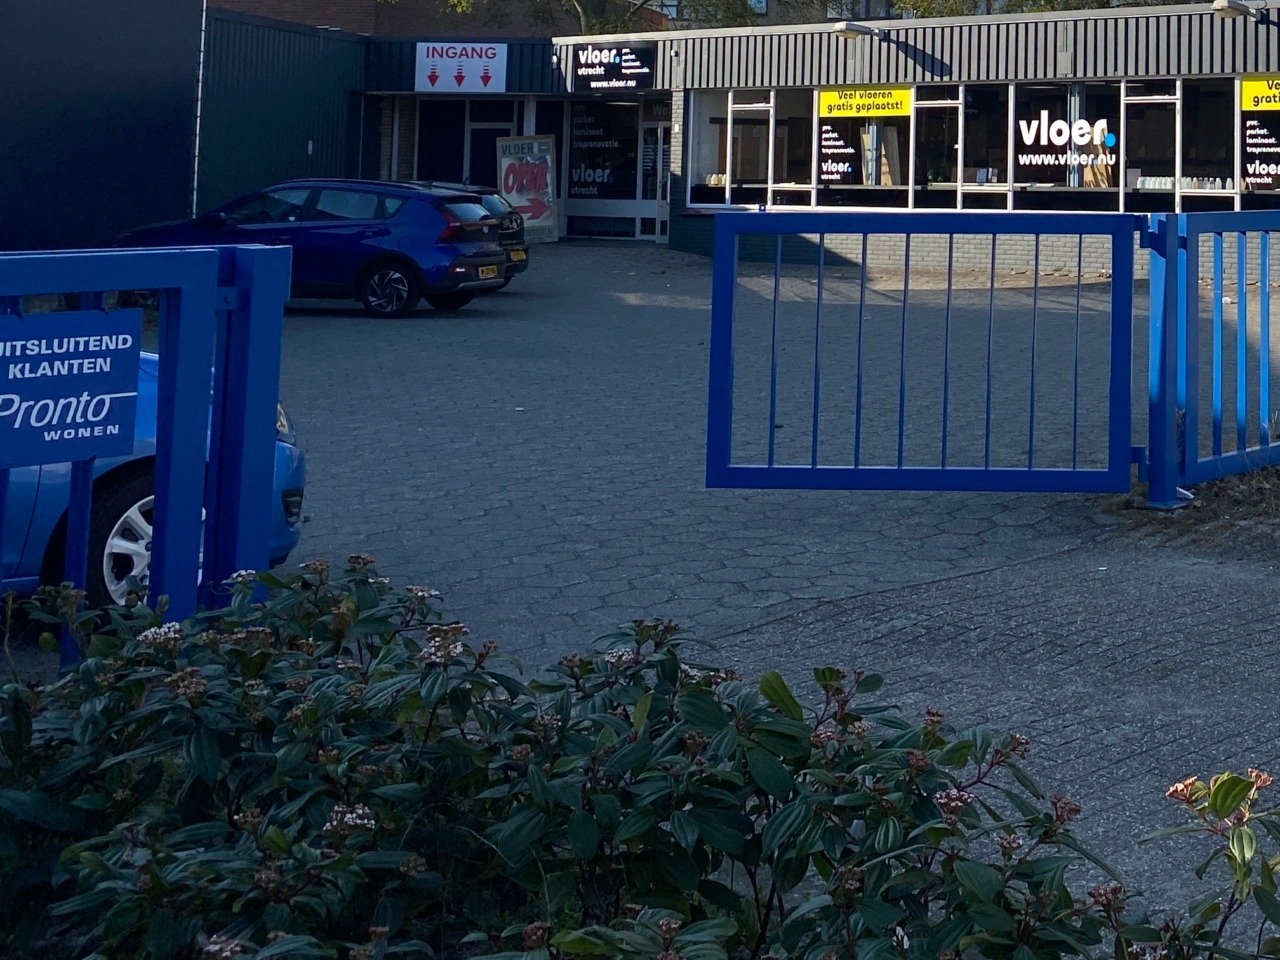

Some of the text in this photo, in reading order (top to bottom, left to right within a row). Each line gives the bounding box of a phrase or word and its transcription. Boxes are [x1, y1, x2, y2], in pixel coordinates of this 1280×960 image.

[426, 46, 497, 59] INGANG
[578, 45, 620, 64] vloer.
[578, 65, 605, 75] utrecht
[590, 78, 637, 89] www.vloer.nu
[838, 89, 893, 100] Veel vloeren
[827, 100, 903, 114] gratis geplaatst!
[1019, 109, 1117, 148] vloer.
[501, 142, 534, 156] VLOER
[1018, 149, 1117, 166] www.vloer.nu
[821, 159, 852, 172] vloer.
[572, 163, 614, 183] vloer.
[1246, 176, 1272, 184] utrecht
[571, 185, 598, 195] utrecht
[8, 357, 111, 379] KLANTEN
[44, 424, 119, 441] WONEN
